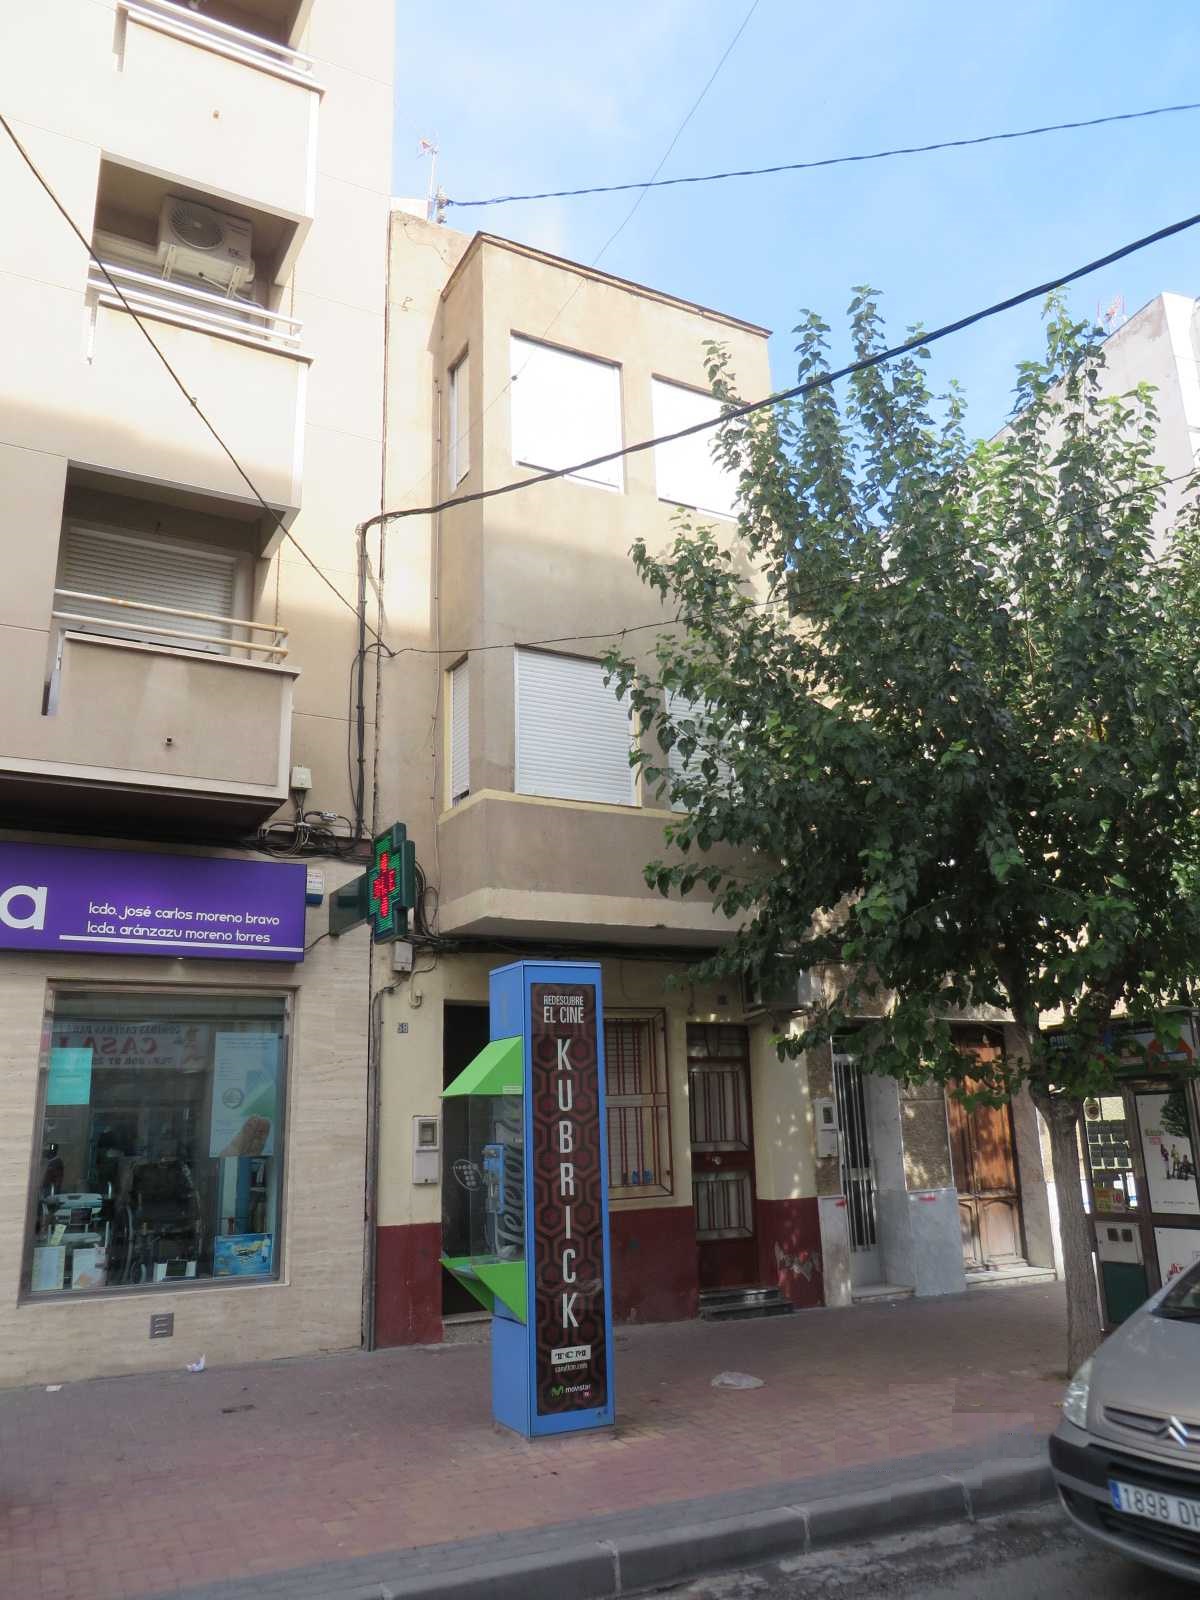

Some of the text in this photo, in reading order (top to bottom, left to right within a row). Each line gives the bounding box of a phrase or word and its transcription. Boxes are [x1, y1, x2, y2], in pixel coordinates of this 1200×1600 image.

[88, 901, 280, 926] lcdo. josé carlos moreno bravo
[87, 921, 271, 943] lcda. aránzazu moreno torres
[543, 995, 585, 1006] REDESCUBRE
[543, 1006, 585, 1024] EL CINE
[557, 1038, 579, 1329] KUBRICK
[555, 1350, 587, 1360] TCM
[565, 1383, 592, 1393] movistar
[1123, 1487, 1170, 1520] 1898
